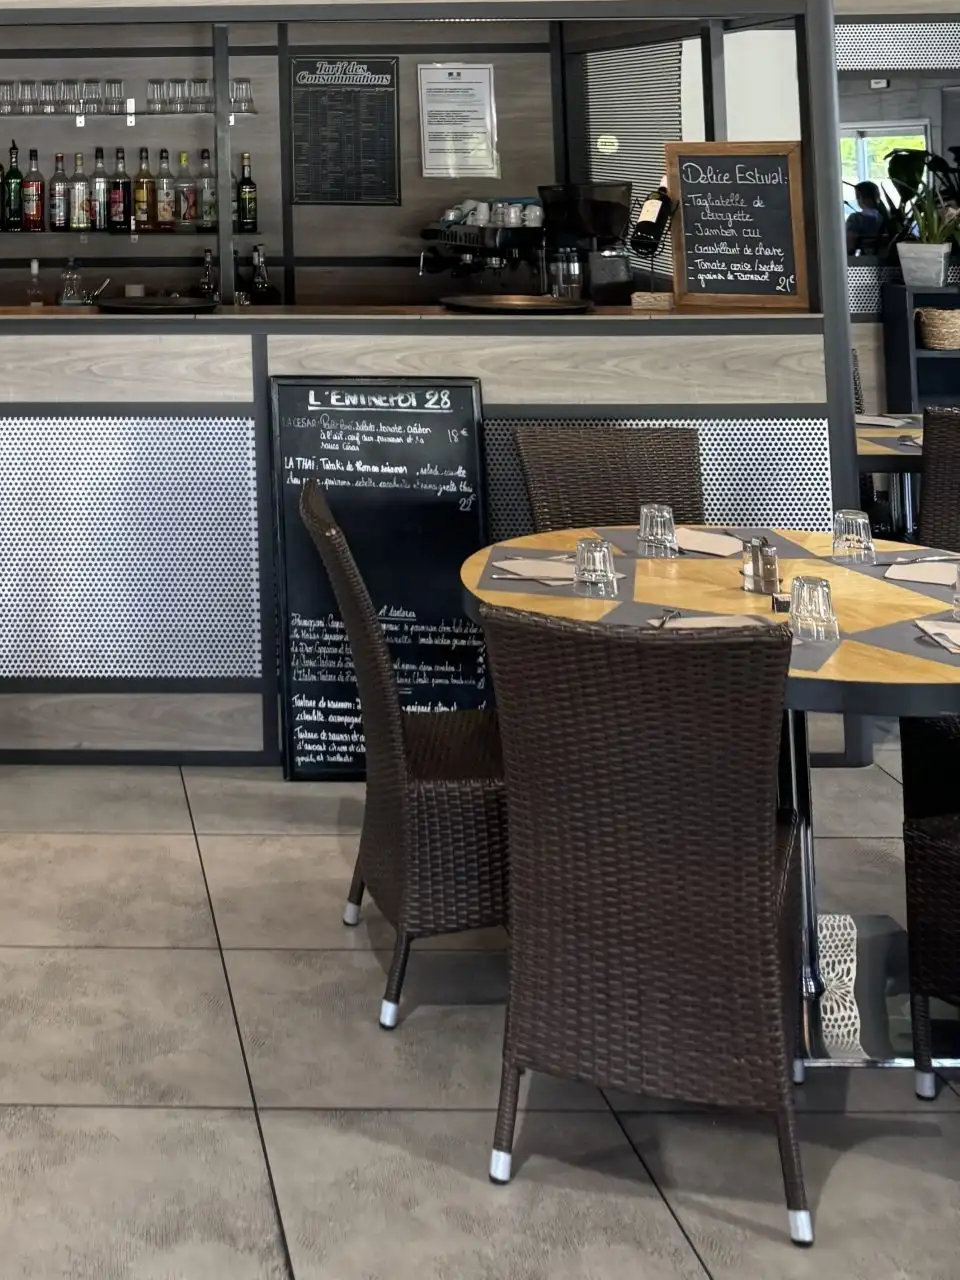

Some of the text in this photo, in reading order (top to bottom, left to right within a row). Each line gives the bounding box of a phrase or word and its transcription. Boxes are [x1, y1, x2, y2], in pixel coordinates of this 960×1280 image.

[345, 61, 367, 75] des
[296, 70, 391, 85] Consommations
[752, 196, 766, 208] de
[701, 210, 754, 228] courgette
[694, 223, 738, 237] Jambon
[743, 244, 753, 255] de
[694, 258, 727, 271] Tomate
[730, 263, 752, 272] cerise
[726, 271, 735, 280] de
[776, 274, 796, 293] 21€
[424, 389, 451, 408] 28
[448, 428, 469, 443] 18€
[285, 457, 295, 470] LA
[346, 461, 355, 472] de
